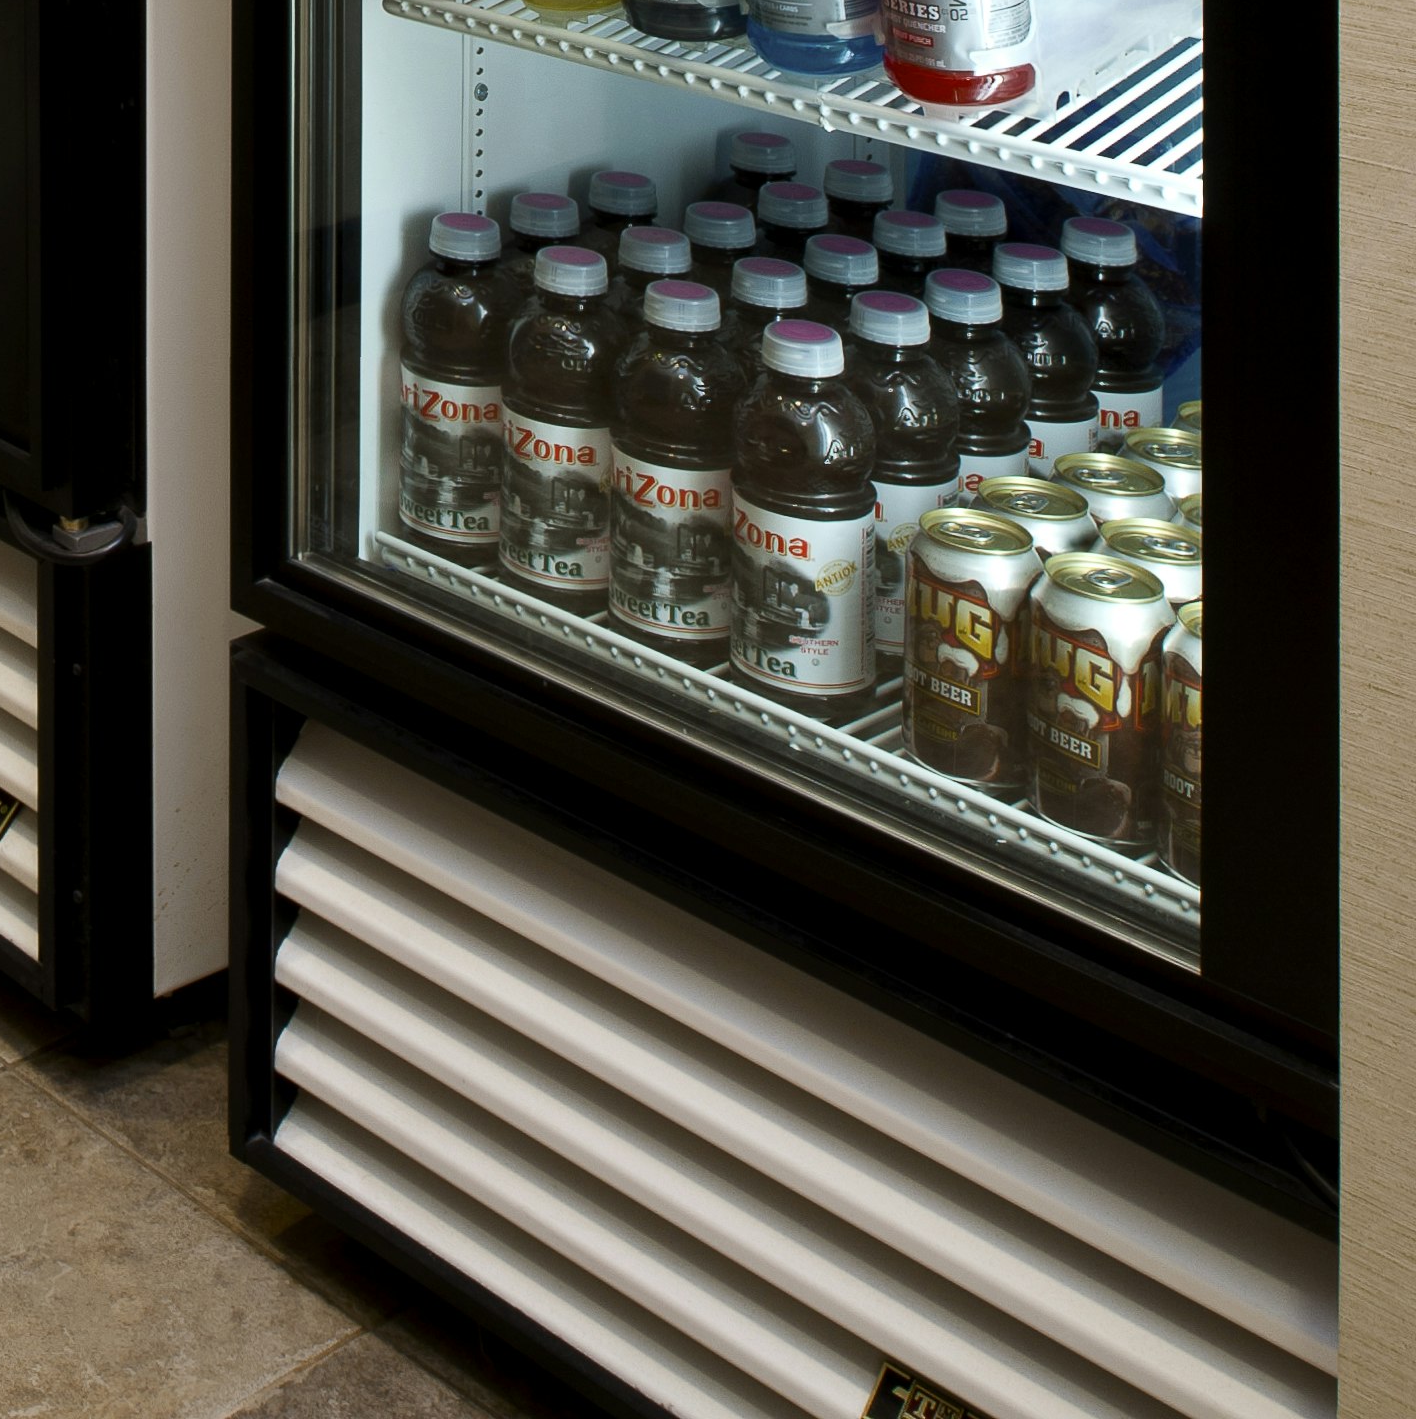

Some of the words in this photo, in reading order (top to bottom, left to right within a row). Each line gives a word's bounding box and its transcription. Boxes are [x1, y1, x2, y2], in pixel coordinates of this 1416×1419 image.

[401, 382, 502, 423] riZona
[507, 420, 597, 467] iZona
[615, 466, 723, 511] riZona
[446, 510, 490, 531] Tea
[735, 506, 814, 561] Zona
[886, 532, 914, 553] ANT
[537, 552, 584, 577] Tea
[663, 603, 711, 627] Tea
[752, 646, 799, 680] Tea
[800, 647, 830, 657] STYLE
[930, 676, 973, 707] BEER
[1050, 727, 1092, 760] BEER
[1163, 768, 1196, 800] ROOT
